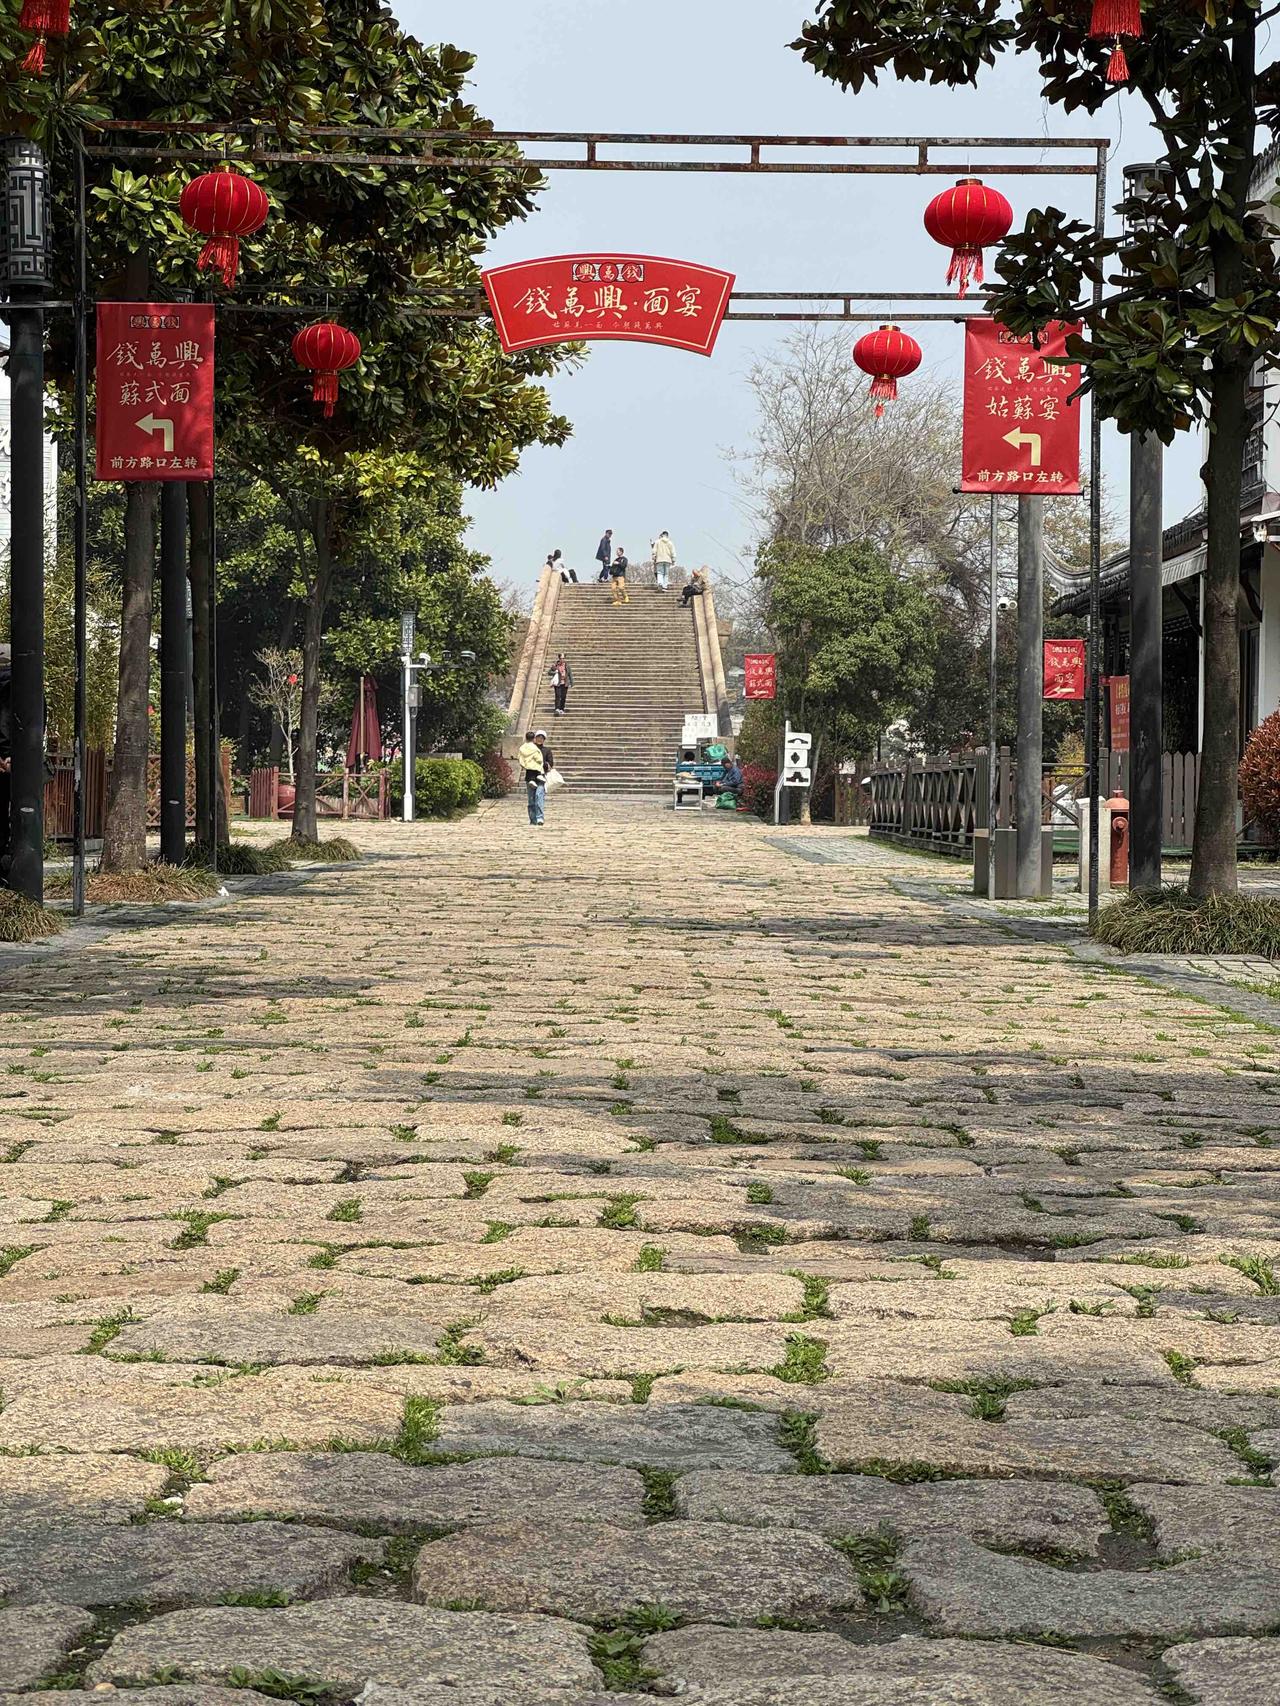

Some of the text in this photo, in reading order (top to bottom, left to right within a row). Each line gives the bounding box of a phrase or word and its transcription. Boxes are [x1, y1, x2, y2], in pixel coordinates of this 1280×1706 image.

[106, 341, 203, 370] 錢萬興
[119, 380, 190, 405] 蘇式面
[985, 395, 1060, 420] 姑蘇宴
[110, 456, 198, 469] 前方路口左转
[977, 469, 1064, 483] 前方路口左转
